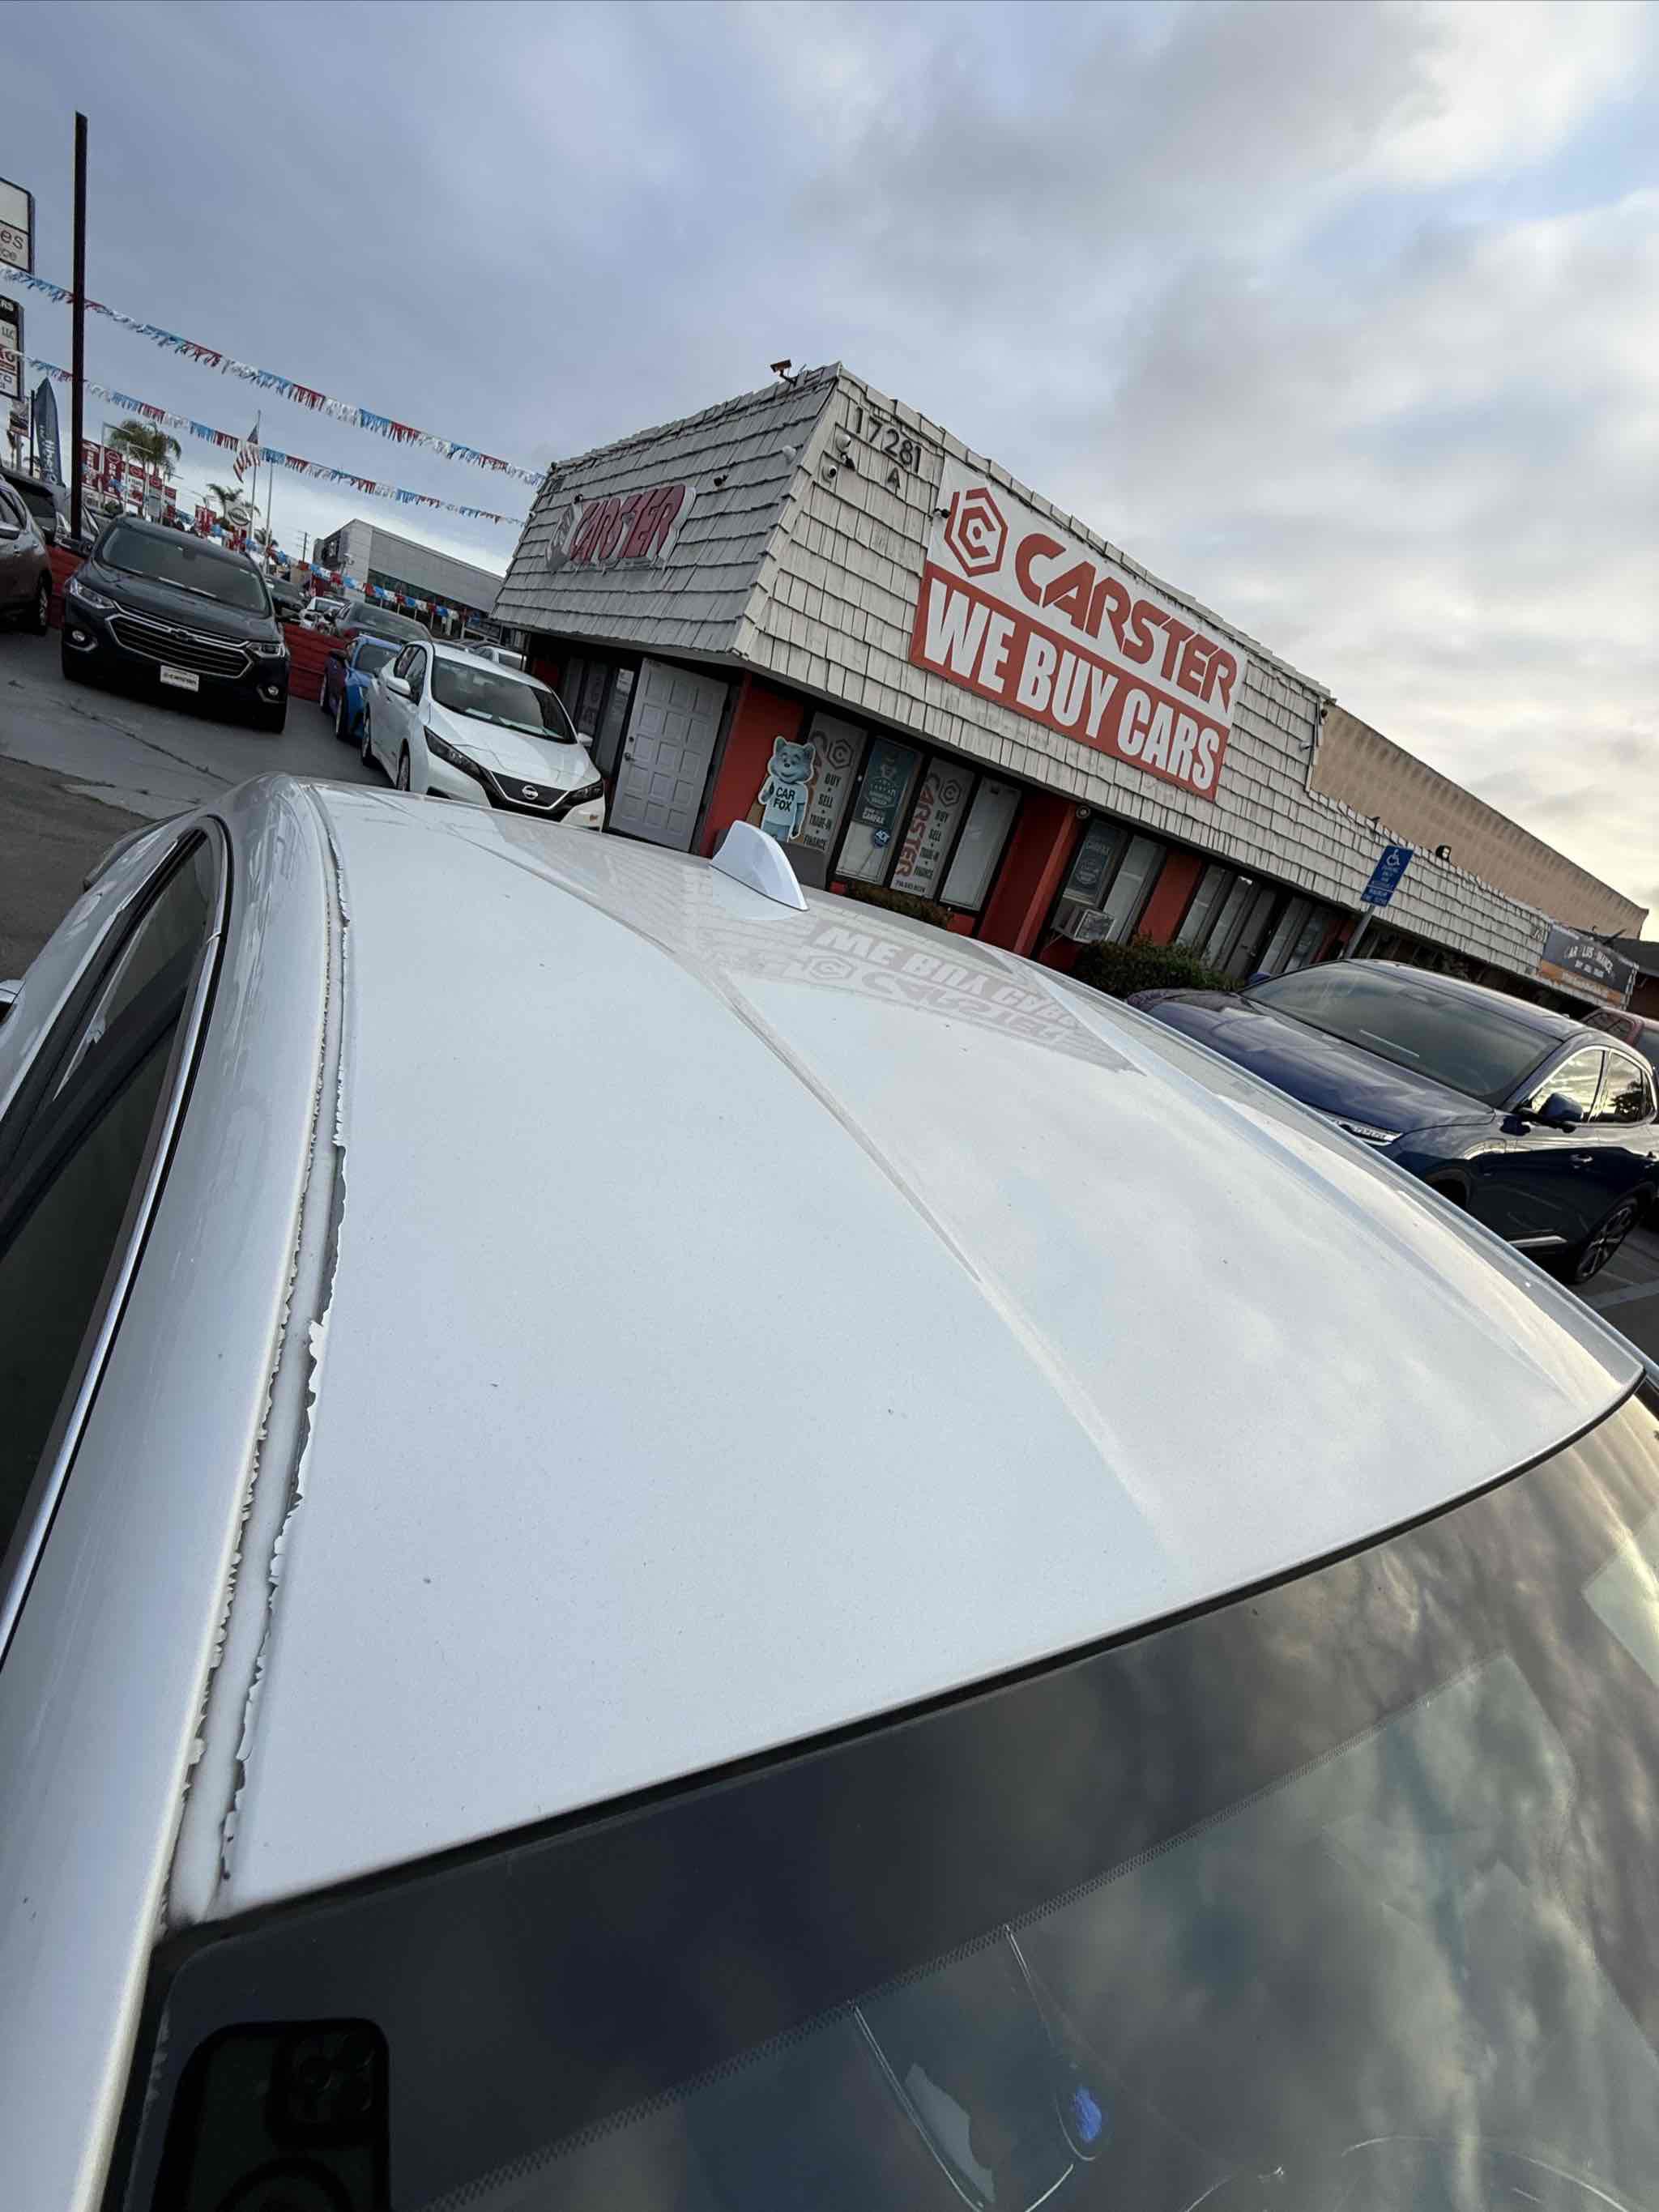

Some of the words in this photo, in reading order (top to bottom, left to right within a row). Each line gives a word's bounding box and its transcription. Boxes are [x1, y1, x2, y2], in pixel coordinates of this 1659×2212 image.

[856, 406, 922, 473] 17281
[1015, 533, 1238, 708] CARSTER
[923, 577, 1017, 694] WE
[1017, 628, 1119, 739] BUY
[1117, 688, 1220, 791] CARS
[825, 773, 842, 787] BUY
[775, 786, 795, 800] CAR
[818, 793, 834, 808] SELL
[773, 799, 792, 812] FOX
